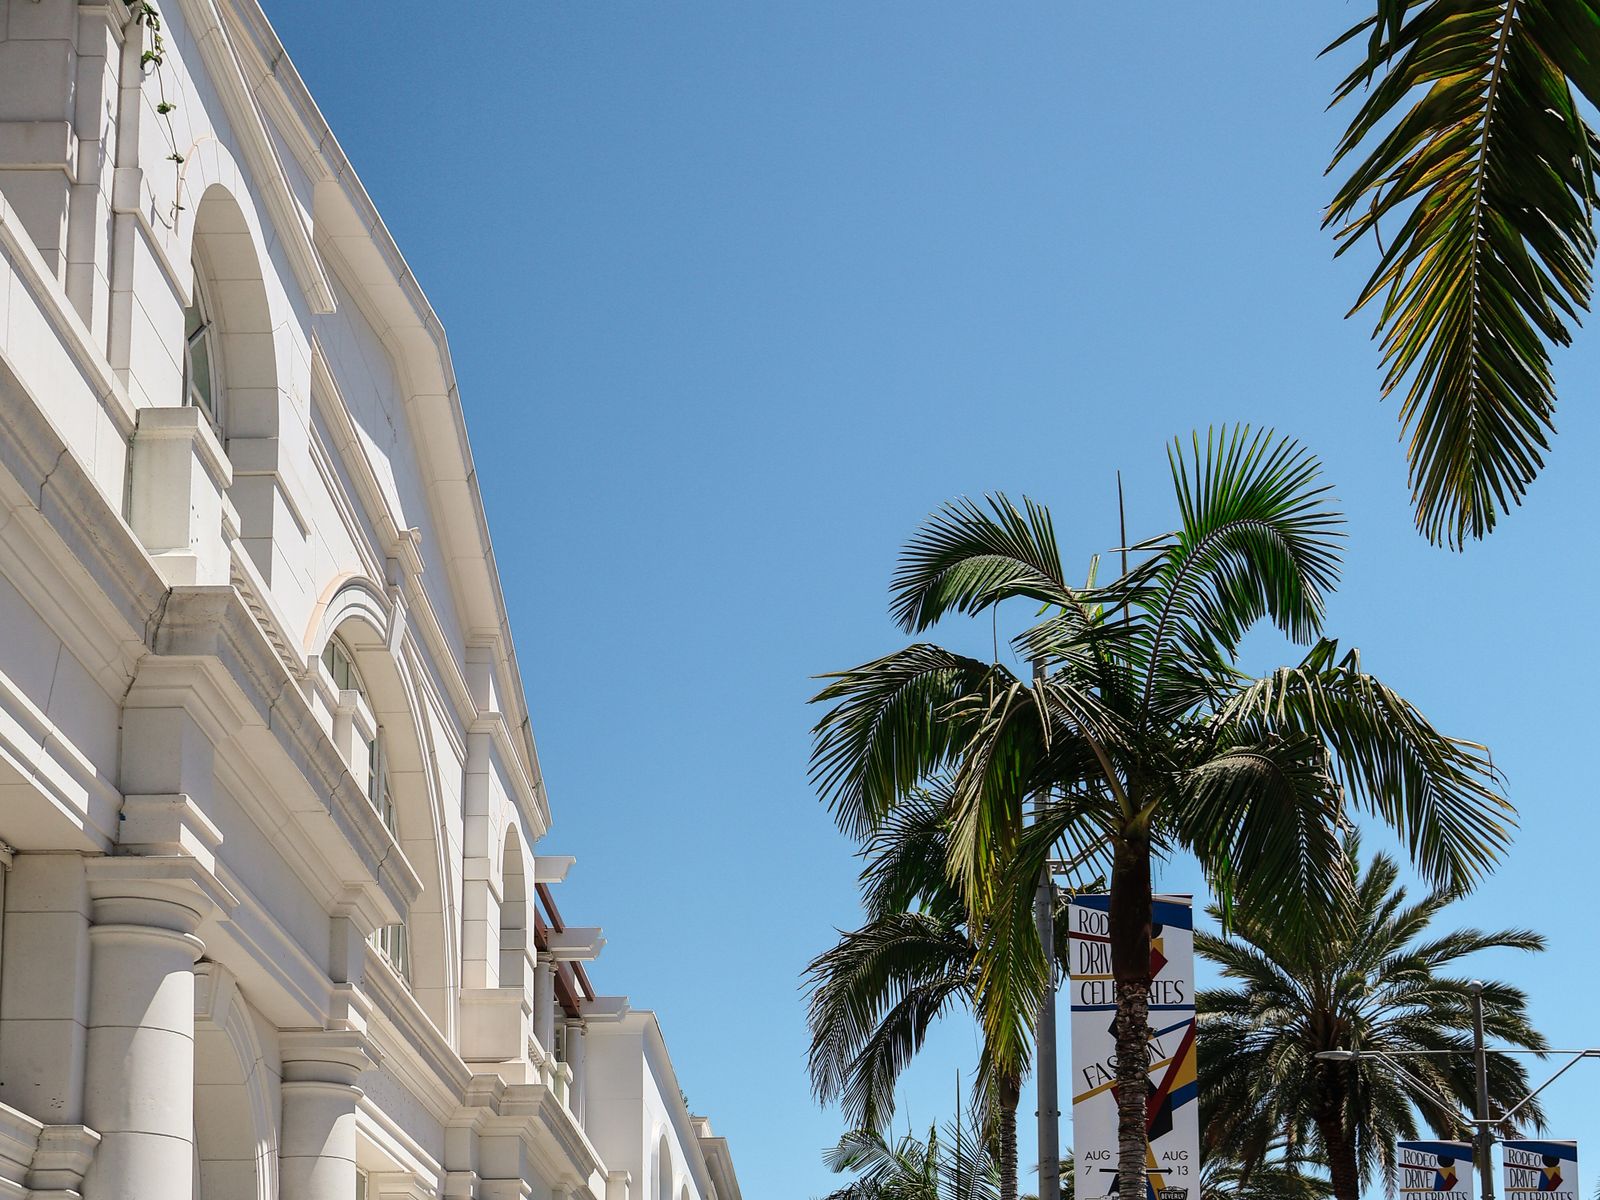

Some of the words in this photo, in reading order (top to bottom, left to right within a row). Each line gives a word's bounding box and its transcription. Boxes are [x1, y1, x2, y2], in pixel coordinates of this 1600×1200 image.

[1079, 909, 1110, 935] ROD
[1080, 941, 1112, 974] DRIV
[1081, 980, 1184, 1005] CELEATES
[1083, 1039, 1166, 1089] FASN
[1084, 1150, 1111, 1161] AUG
[1162, 1150, 1189, 1161] AUG
[1404, 1149, 1437, 1167] RODEO
[1508, 1149, 1541, 1167] RODEO
[1085, 1166, 1092, 1176] 7
[1177, 1166, 1189, 1176] 13
[1405, 1168, 1433, 1188] DRIVE
[1509, 1168, 1538, 1188] DRIVE
